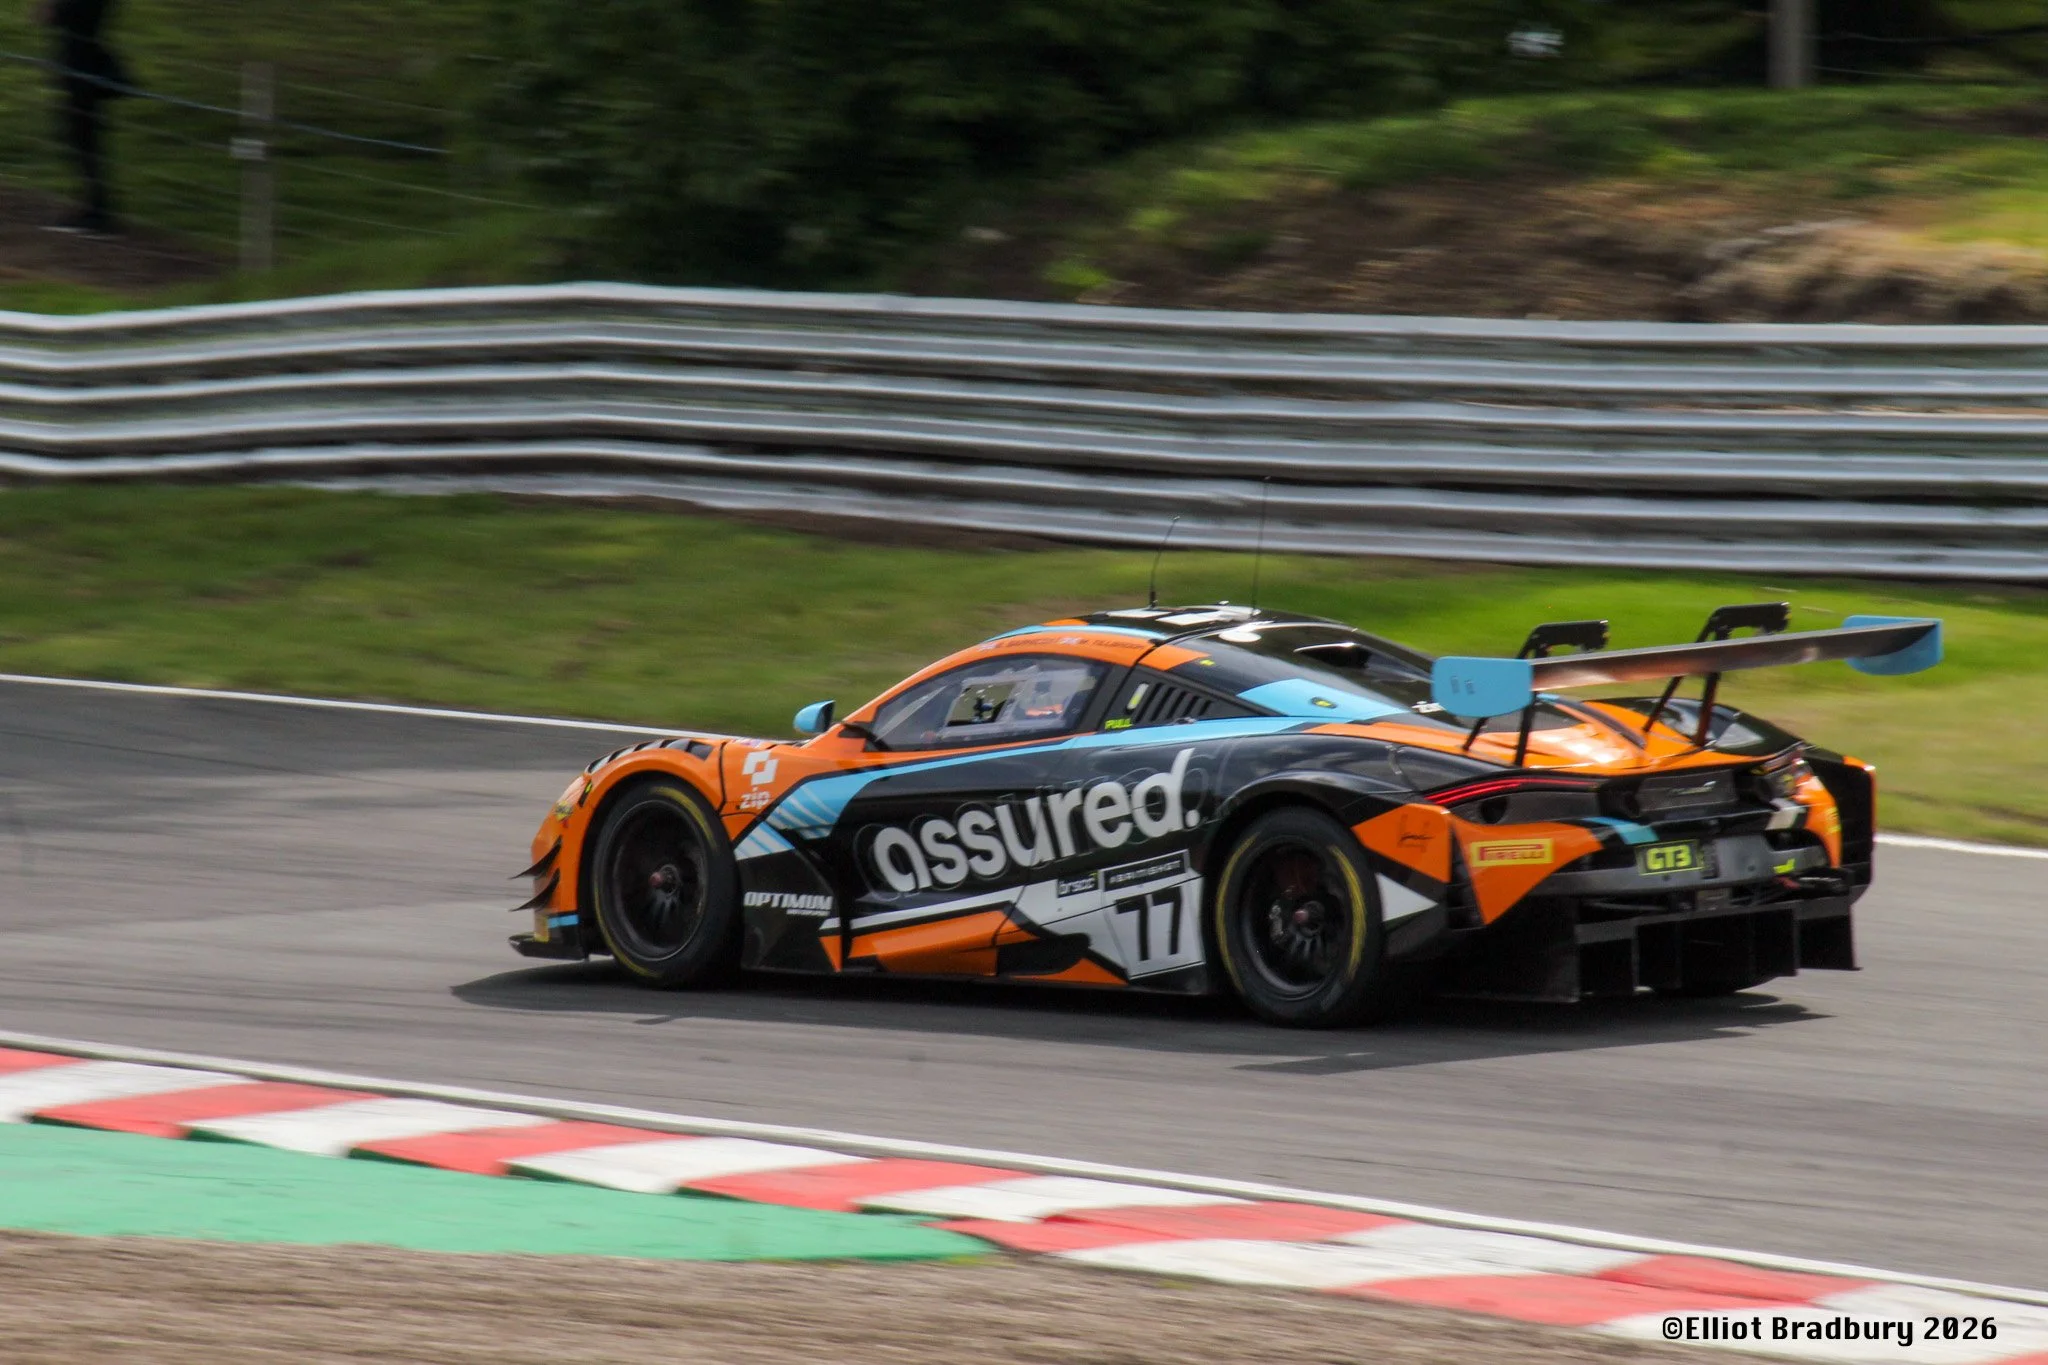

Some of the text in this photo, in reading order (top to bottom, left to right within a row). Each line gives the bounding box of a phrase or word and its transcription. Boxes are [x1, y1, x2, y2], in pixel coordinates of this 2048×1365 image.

[1105, 718, 1133, 729] PULL
[740, 786, 770, 809] zip
[873, 748, 1200, 892] assured.
[1480, 844, 1545, 861] PIRELLI
[1647, 845, 1692, 870] GT3
[743, 892, 833, 910] OPTIMUM
[1115, 886, 1182, 961] 77
